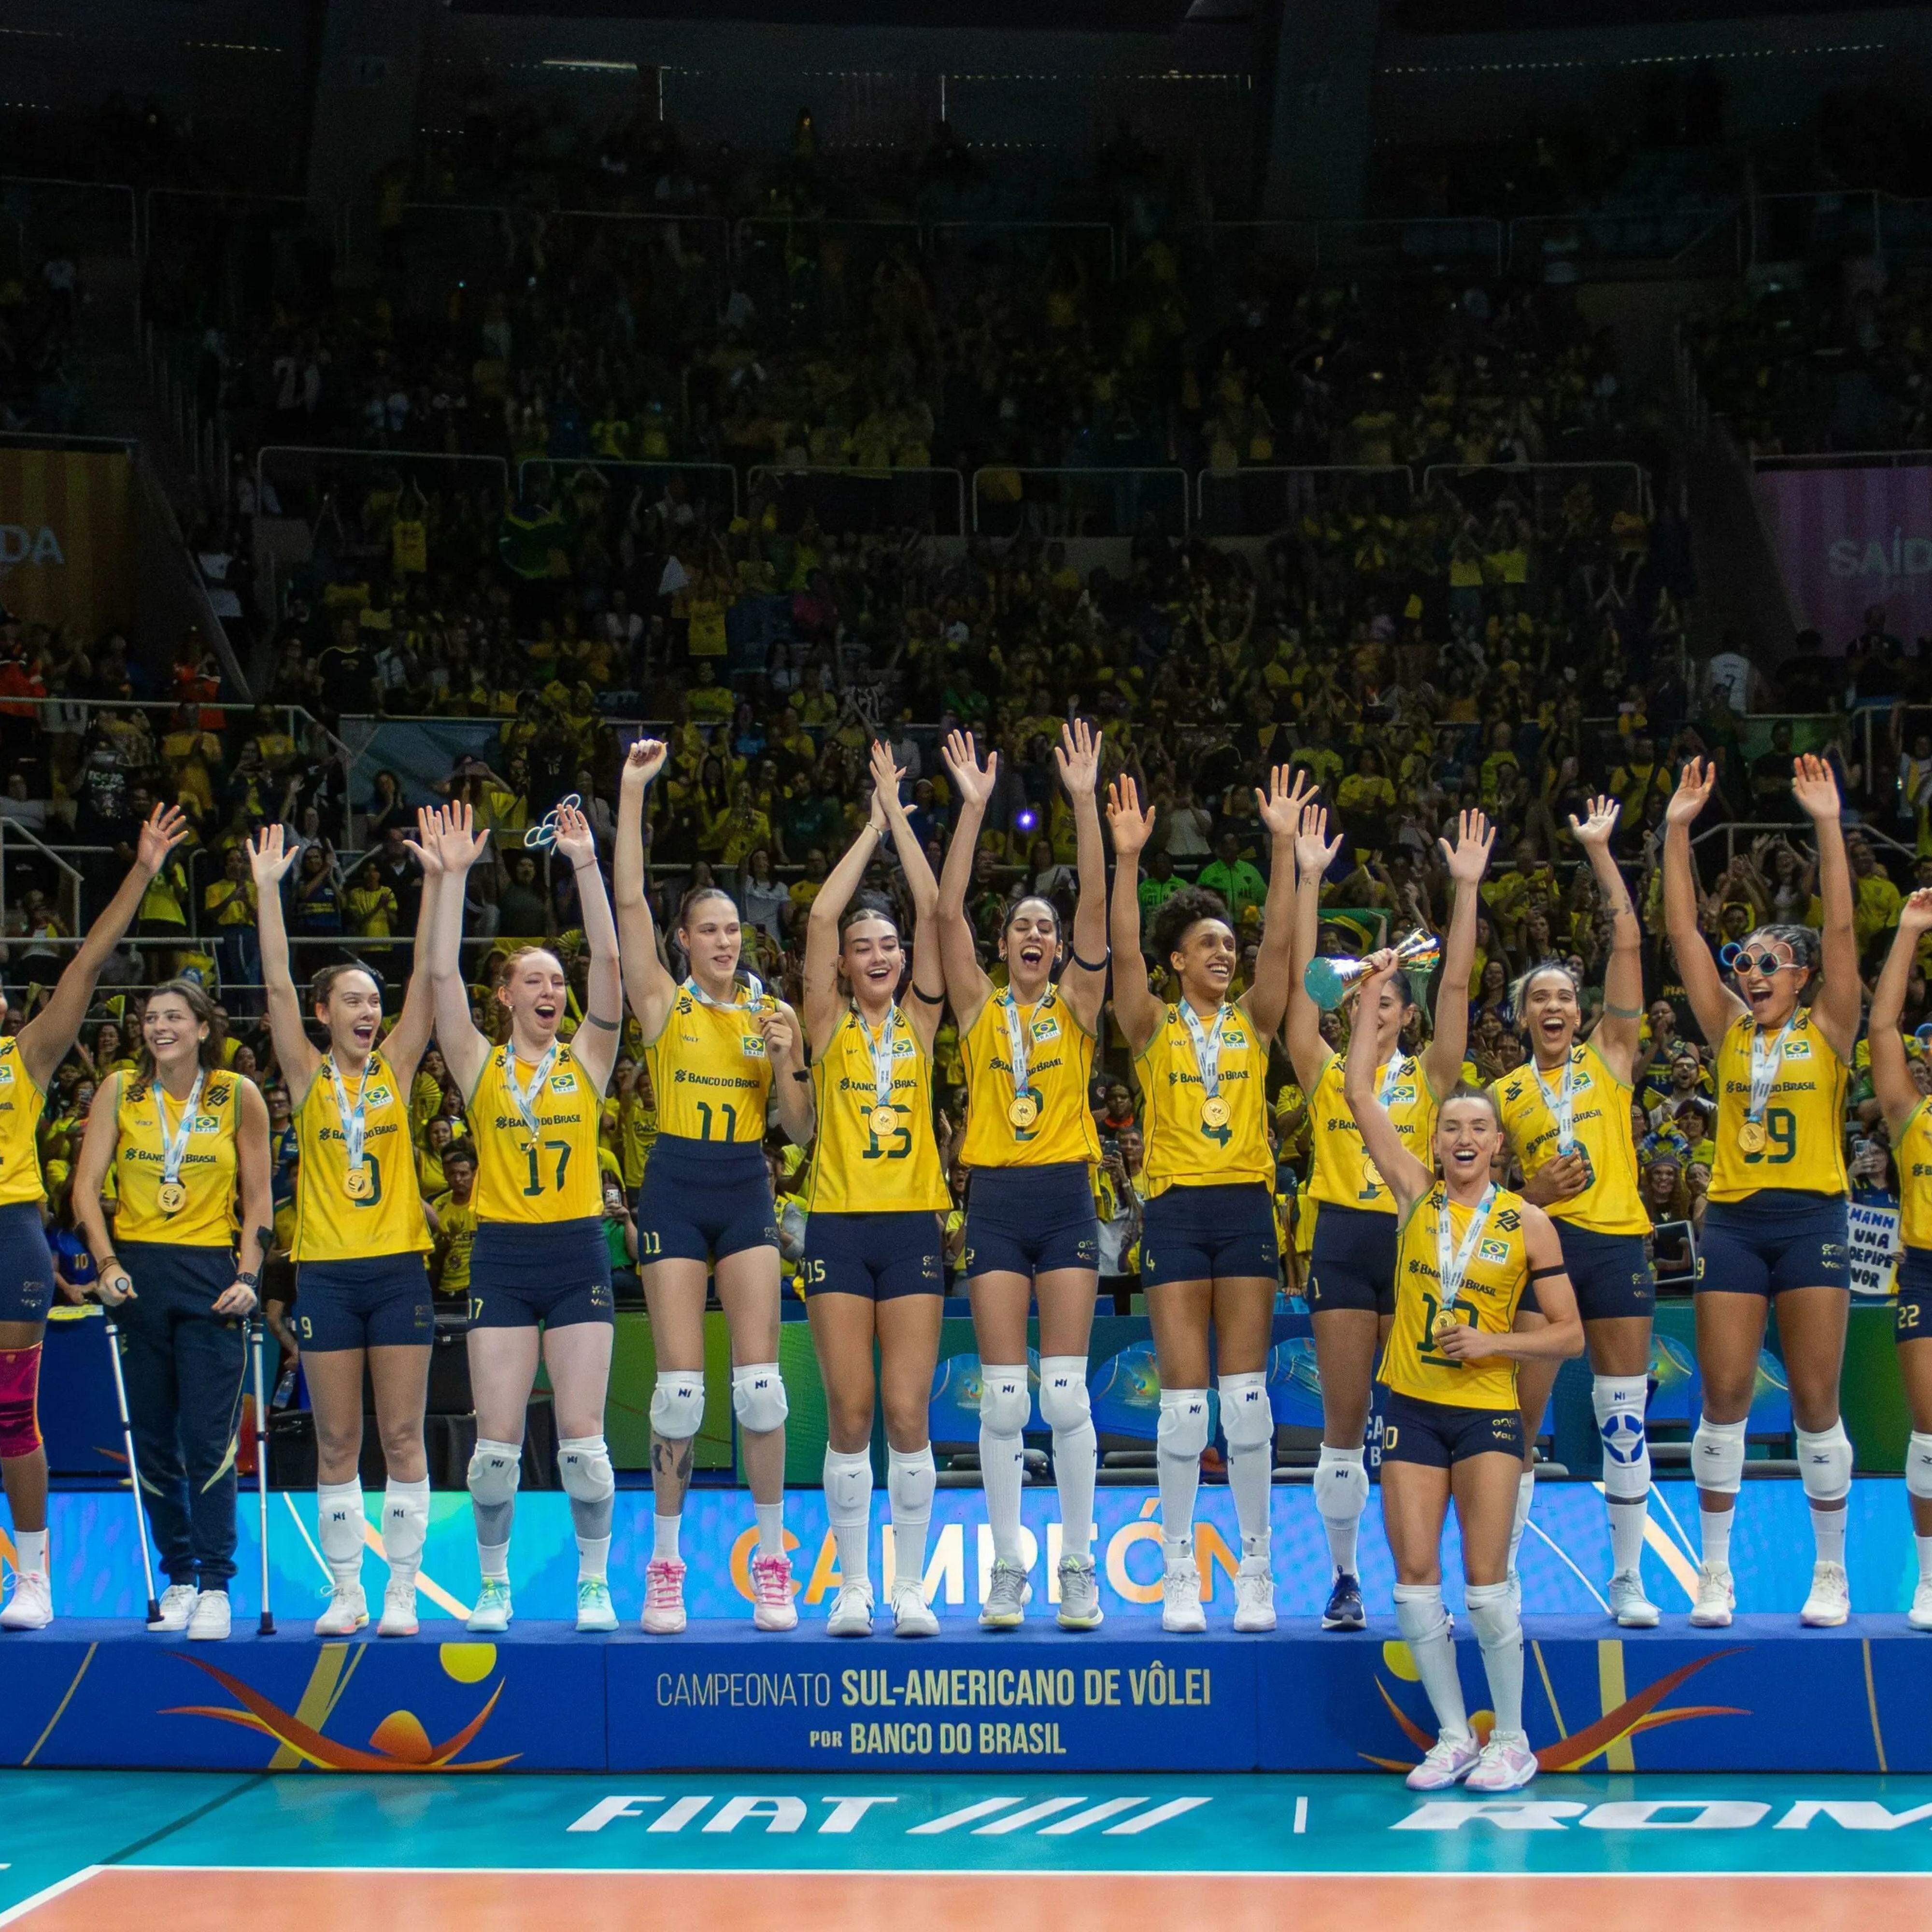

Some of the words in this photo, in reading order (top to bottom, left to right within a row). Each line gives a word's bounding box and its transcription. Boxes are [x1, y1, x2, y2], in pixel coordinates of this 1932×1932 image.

[688, 1072, 720, 1086] BANCO
[722, 1078, 734, 1087] DO
[894, 1079, 918, 1090] BRAS
[1181, 1073, 1205, 1084] BANC
[1782, 1081, 1817, 1092] BRASIL
[541, 1117, 553, 1126] DO
[554, 1114, 582, 1124] BRASIL
[697, 1101, 737, 1142] 11
[1339, 1120, 1359, 1130] BAN
[1394, 1124, 1416, 1134] RASIL
[861, 1104, 912, 1159] 15
[138, 1150, 165, 1162] BANC
[185, 1153, 217, 1164] BRASIL
[521, 1140, 572, 1196] 17
[1849, 1207, 1895, 1229] MANN
[643, 1231, 662, 1254] 11
[808, 1259, 825, 1283] 15
[1465, 1279, 1496, 1297] BRASIL
[468, 1297, 483, 1320] 17
[1898, 1304, 1920, 1329] 22
[300, 1316, 313, 1338] 9
[656, 1673, 830, 1707] CAMPEONATO
[841, 1669, 1075, 1706] SUL-AMERICANO
[1084, 1669, 1122, 1705] DE
[1128, 1660, 1211, 1705] VÔLEI
[810, 1730, 842, 1748] POR
[850, 1722, 933, 1755] BANCO
[939, 1722, 972, 1755] DO
[979, 1722, 1066, 1755] BRASIL
[566, 1795, 899, 1833] FIAT
